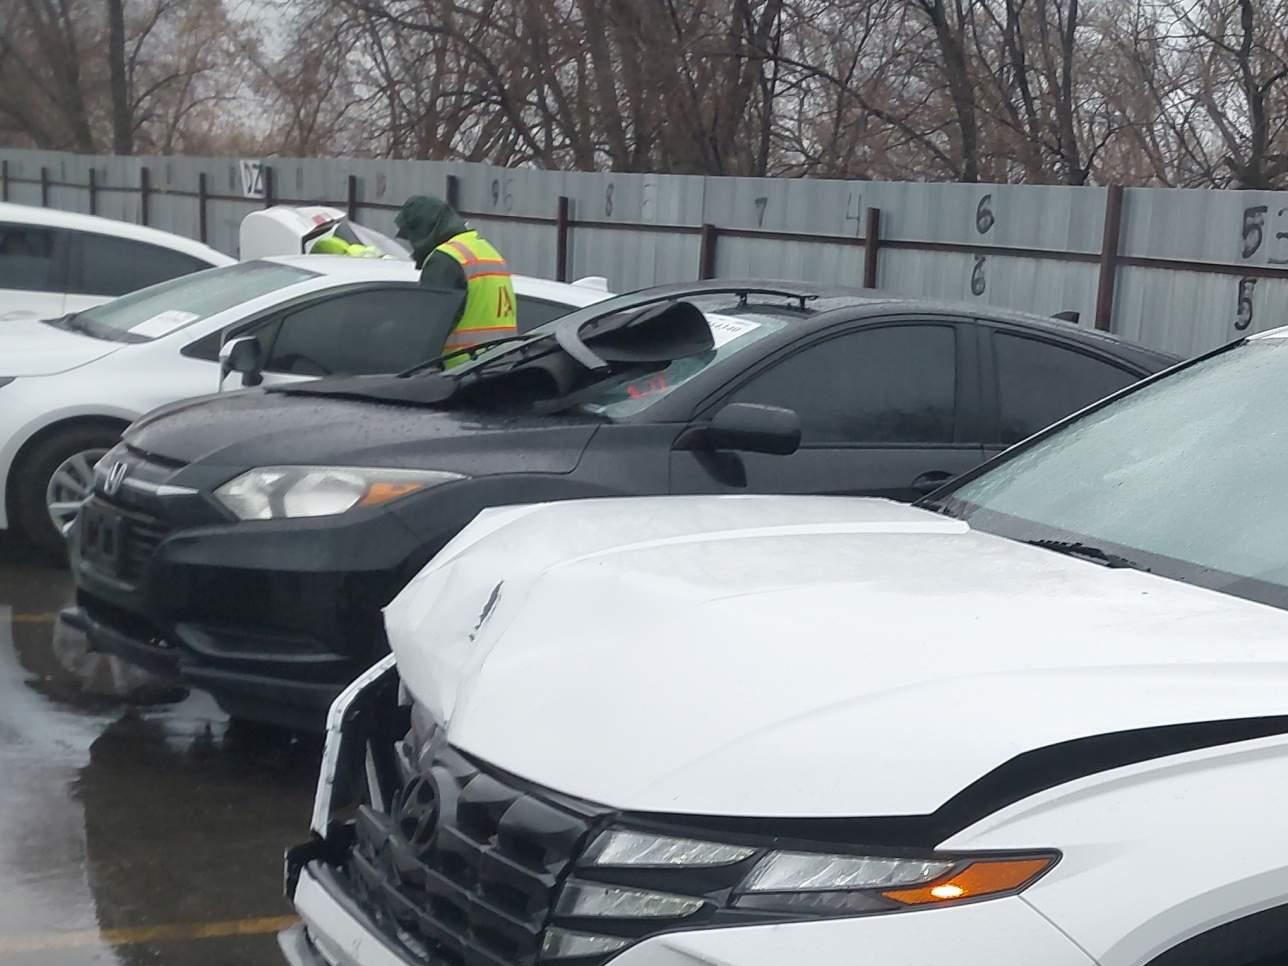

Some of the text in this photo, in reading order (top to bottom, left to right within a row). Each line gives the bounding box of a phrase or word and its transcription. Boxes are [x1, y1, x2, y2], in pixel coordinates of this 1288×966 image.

[975, 194, 995, 235] 6
[971, 255, 986, 296] 6
[1234, 278, 1257, 331] 5
